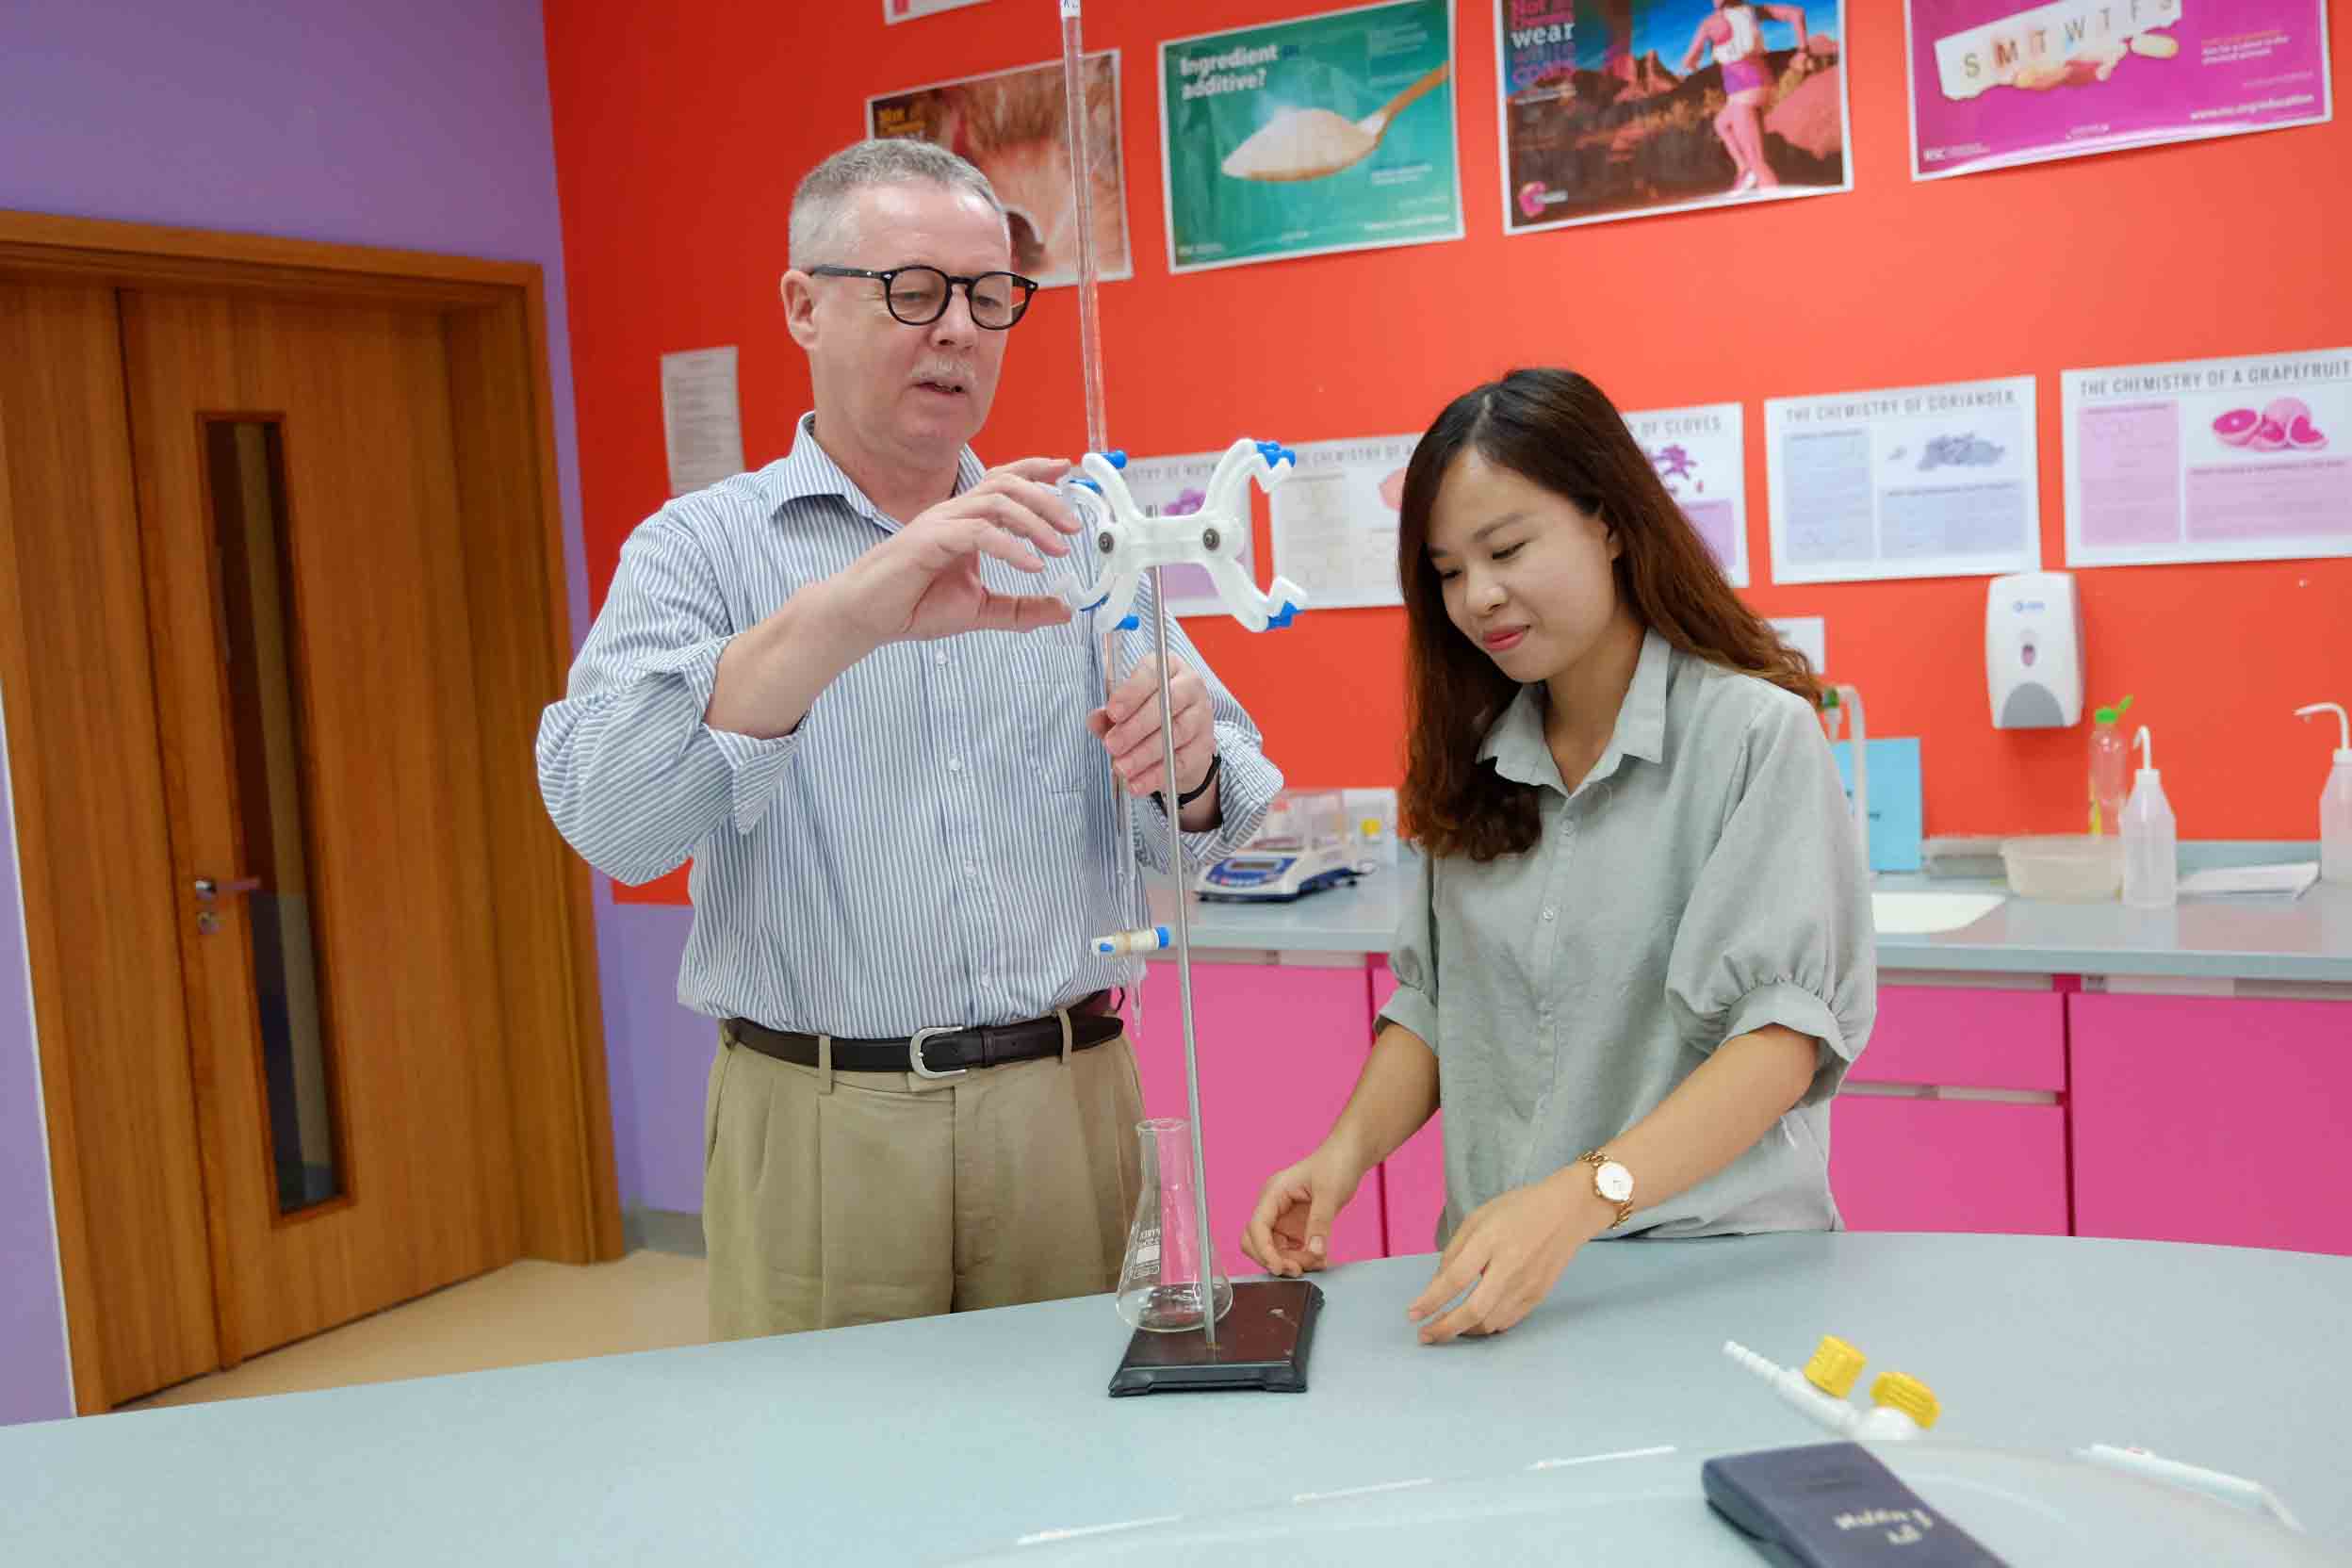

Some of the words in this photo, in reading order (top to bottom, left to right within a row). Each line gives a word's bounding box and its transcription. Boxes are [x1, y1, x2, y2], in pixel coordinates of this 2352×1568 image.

[1511, 22, 1576, 48] wear
[1964, 53, 1981, 78] S
[1994, 41, 2018, 67] M
[2029, 29, 2047, 54] T
[2065, 17, 2086, 42] W
[2099, 8, 2112, 30] T
[1180, 44, 1279, 76] Ingredient
[1182, 68, 1267, 100] additive?
[2081, 380, 2107, 397] THE
[2113, 372, 2202, 394] CHEMISTRY
[2208, 369, 2227, 386] OF
[2232, 368, 2244, 384] A
[2248, 359, 2352, 384] GRAPEFRUIT
[1787, 408, 1811, 423] THE
[1817, 400, 1899, 421] CHEMISTRY
[1904, 397, 1924, 415] OF
[1929, 389, 2016, 413] CORIANDER
